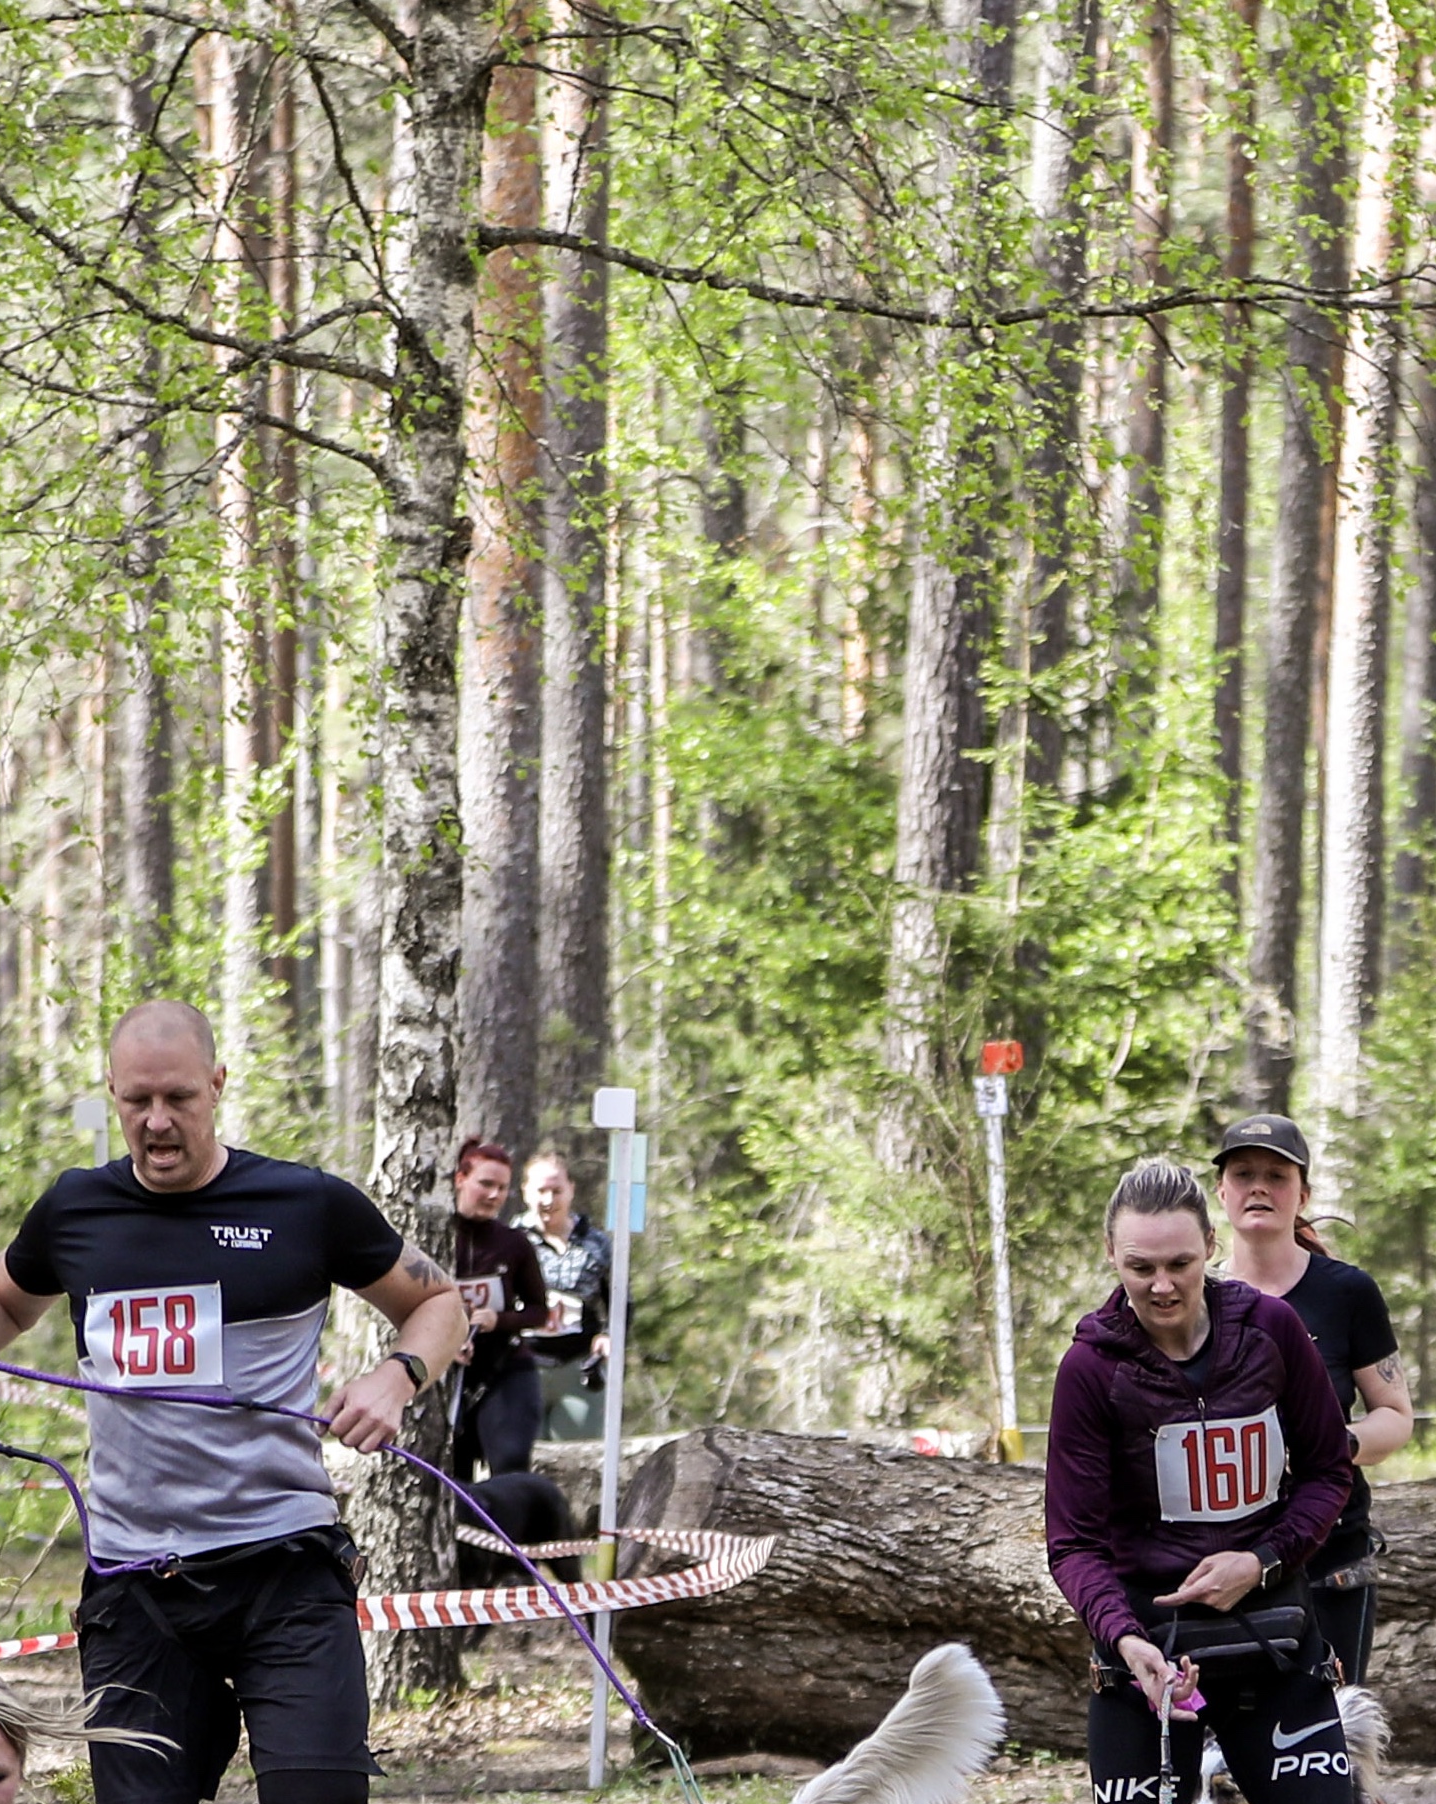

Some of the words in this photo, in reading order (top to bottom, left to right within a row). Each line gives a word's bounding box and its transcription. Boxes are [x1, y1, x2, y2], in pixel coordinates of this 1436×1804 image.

[210, 1225, 272, 1242] TRUST
[109, 1293, 195, 1377] 158
[1181, 1421, 1266, 1512] 160
[1271, 1751, 1349, 1780] PRO
